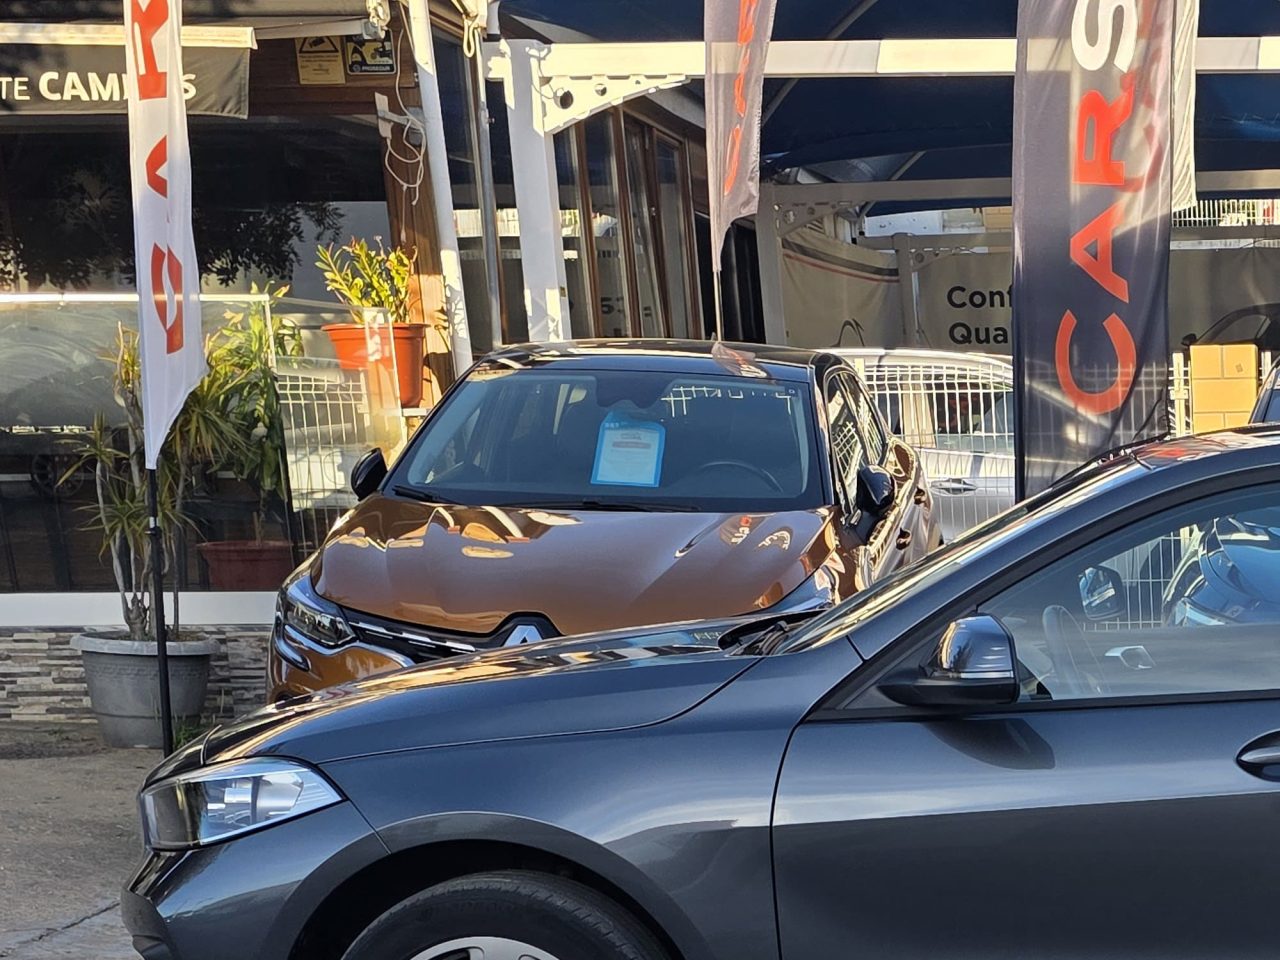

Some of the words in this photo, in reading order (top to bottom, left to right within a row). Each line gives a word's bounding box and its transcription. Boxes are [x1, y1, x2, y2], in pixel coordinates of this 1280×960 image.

[39, 71, 196, 101] CAMS
[1055, 0, 1139, 414] CARS
[949, 322, 1008, 344] Qua
